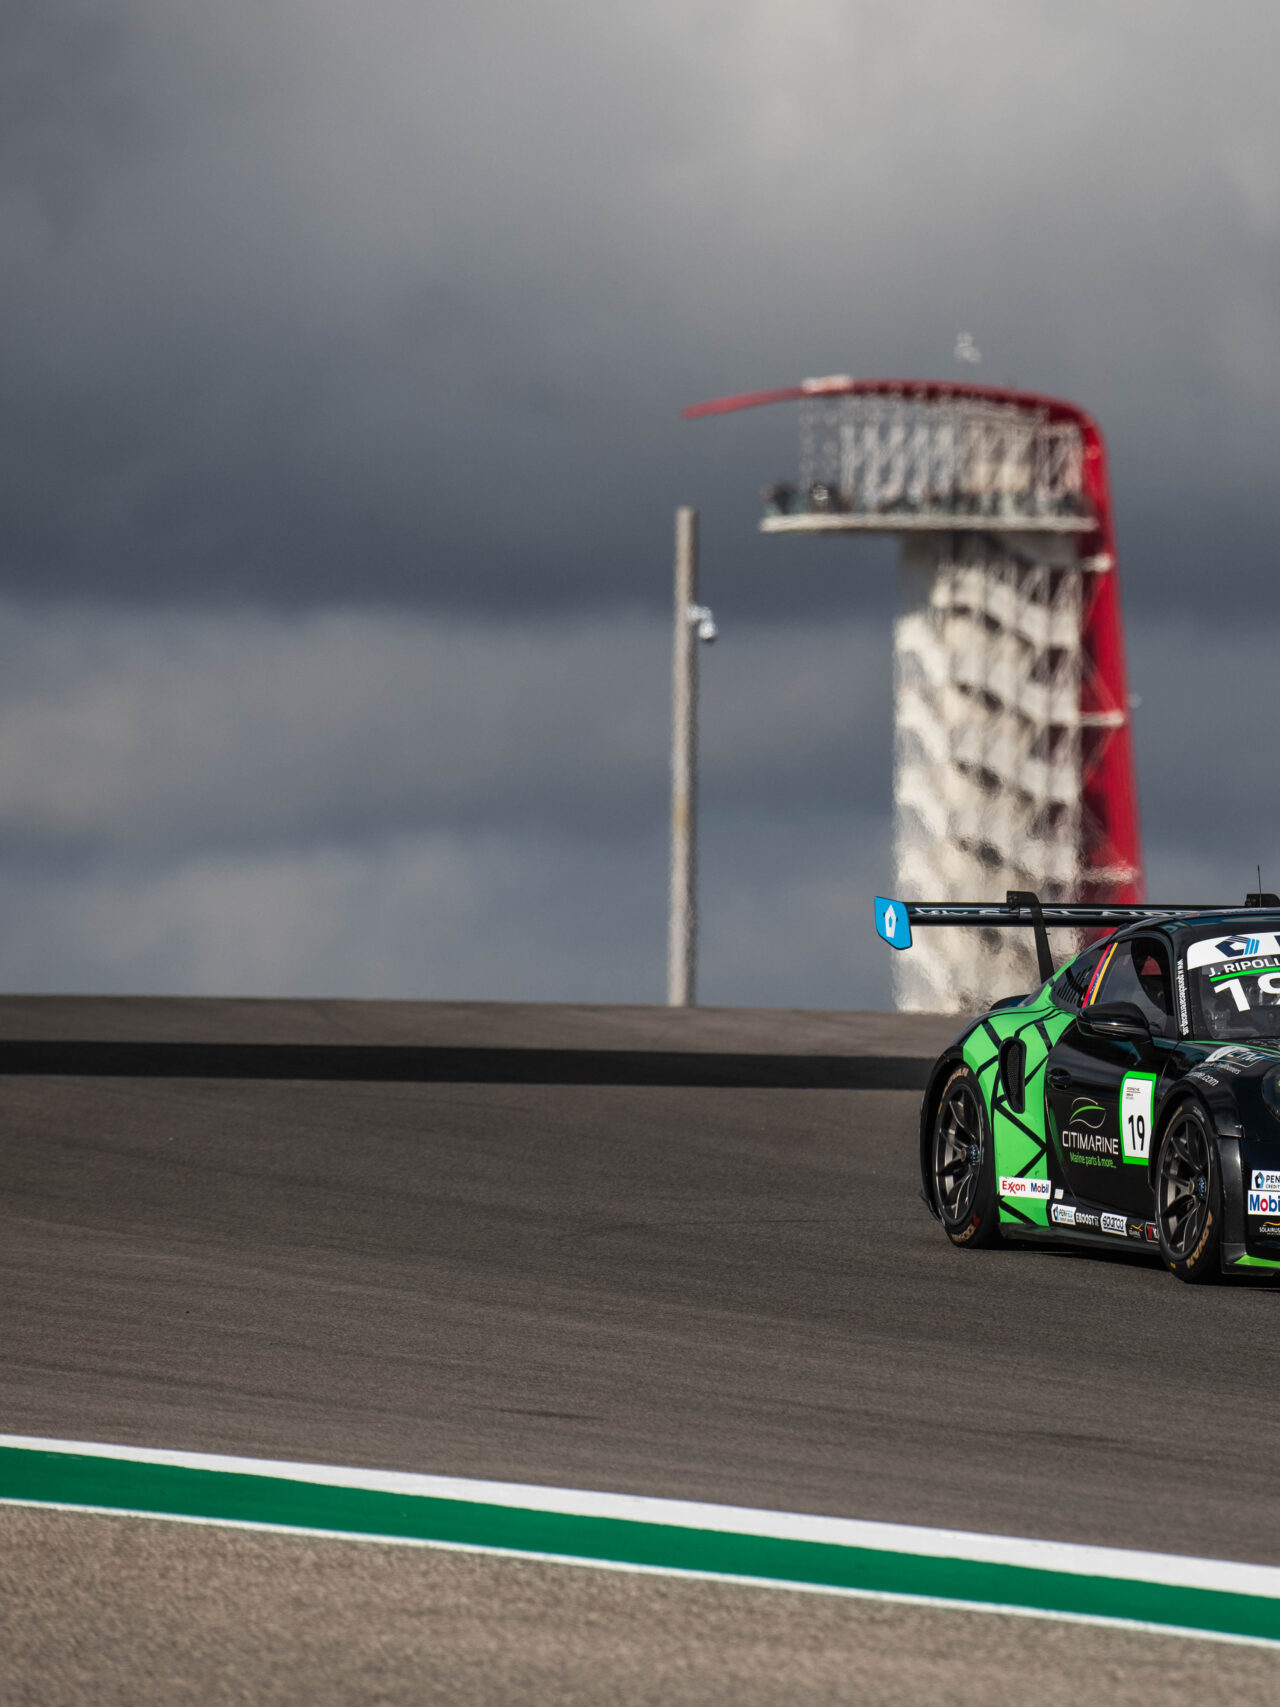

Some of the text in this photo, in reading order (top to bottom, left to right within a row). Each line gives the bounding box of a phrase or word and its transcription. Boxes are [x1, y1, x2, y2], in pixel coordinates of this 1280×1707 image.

[1208, 967, 1221, 977] J.
[1128, 1114, 1145, 1151] 19
[1062, 1130, 1119, 1155] CITIMARINE
[1069, 1151, 1085, 1164] Marine
[1002, 1180, 1049, 1194] Exxon Mobil
[1102, 1215, 1125, 1230] sparco
